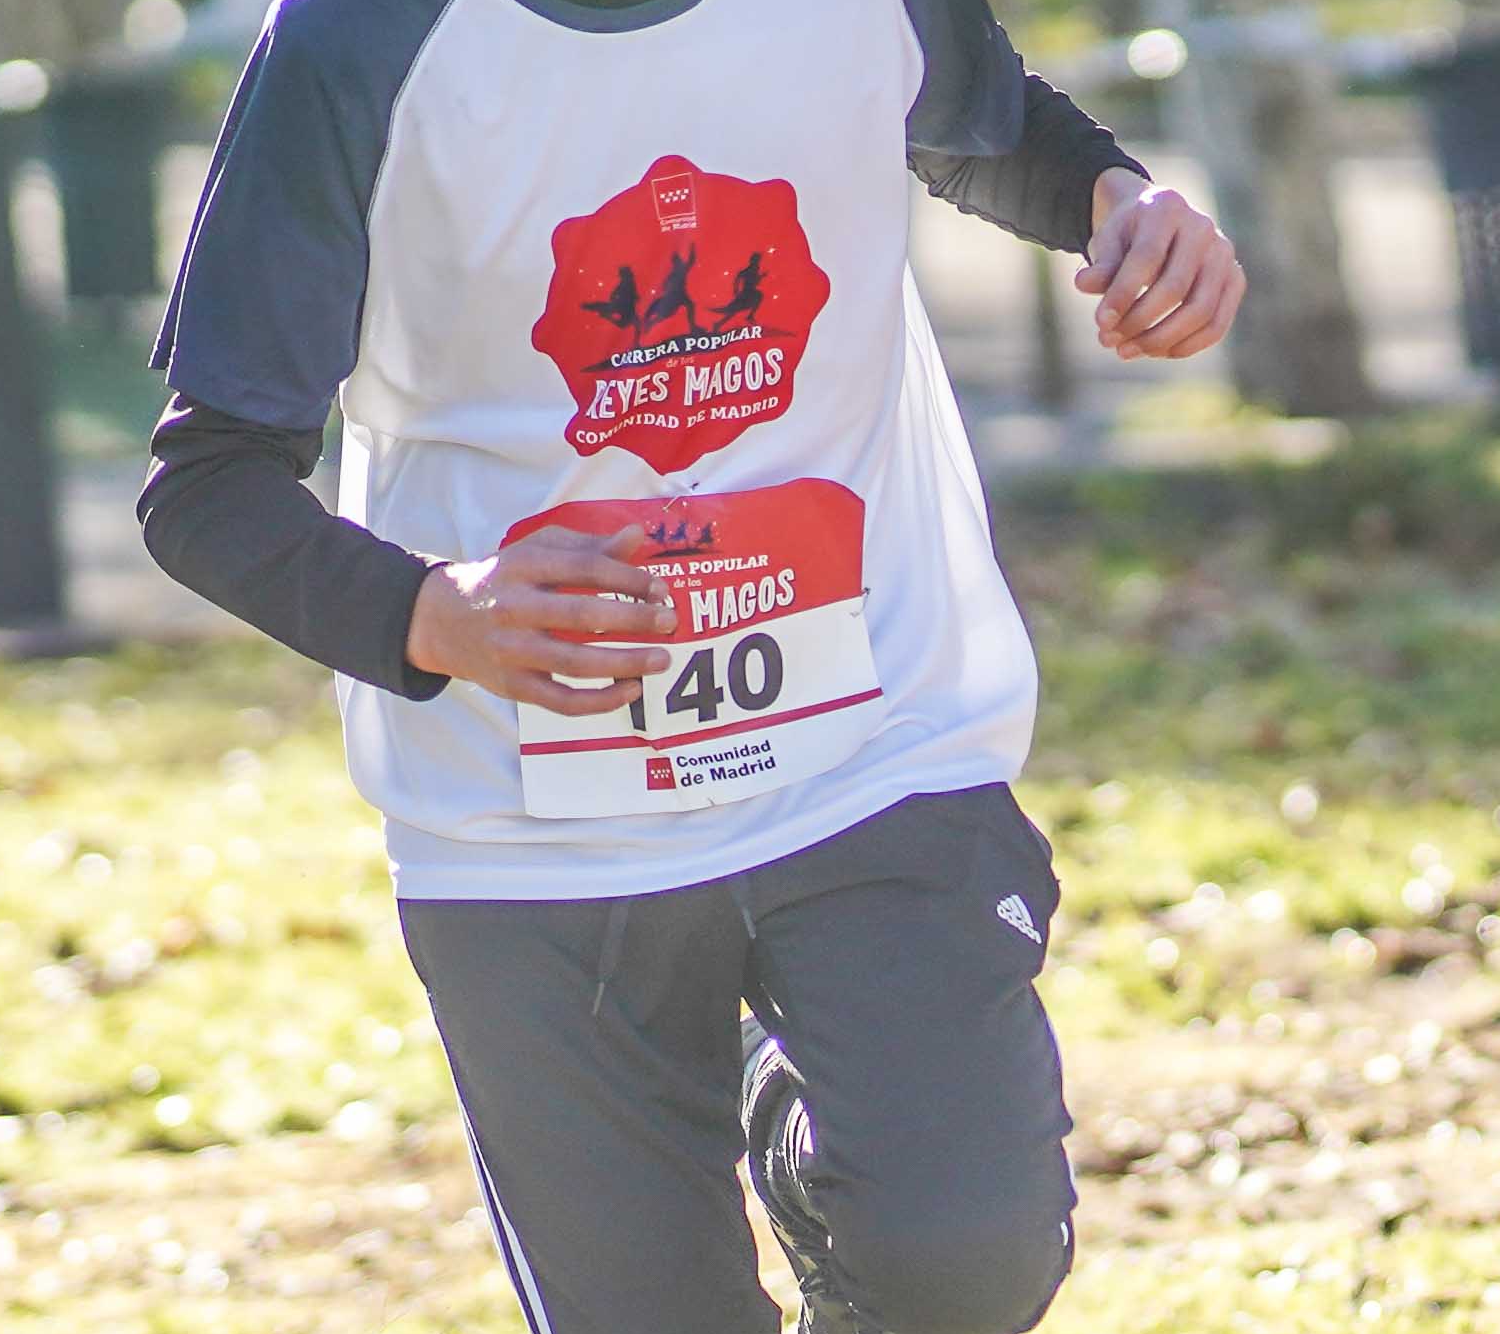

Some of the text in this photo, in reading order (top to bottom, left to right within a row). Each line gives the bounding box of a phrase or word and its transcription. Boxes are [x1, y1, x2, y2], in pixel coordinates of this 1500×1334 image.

[611, 325, 763, 368] CARRERA POPULAR
[683, 348, 784, 406] MAGOS
[575, 396, 779, 444] COMUNIDAD DE MADRID
[673, 578, 702, 588] de los
[688, 554, 769, 575] POPULAR
[689, 568, 796, 634] MAGOS
[676, 739, 772, 768] Comunidad
[680, 756, 777, 788] de Madrid
